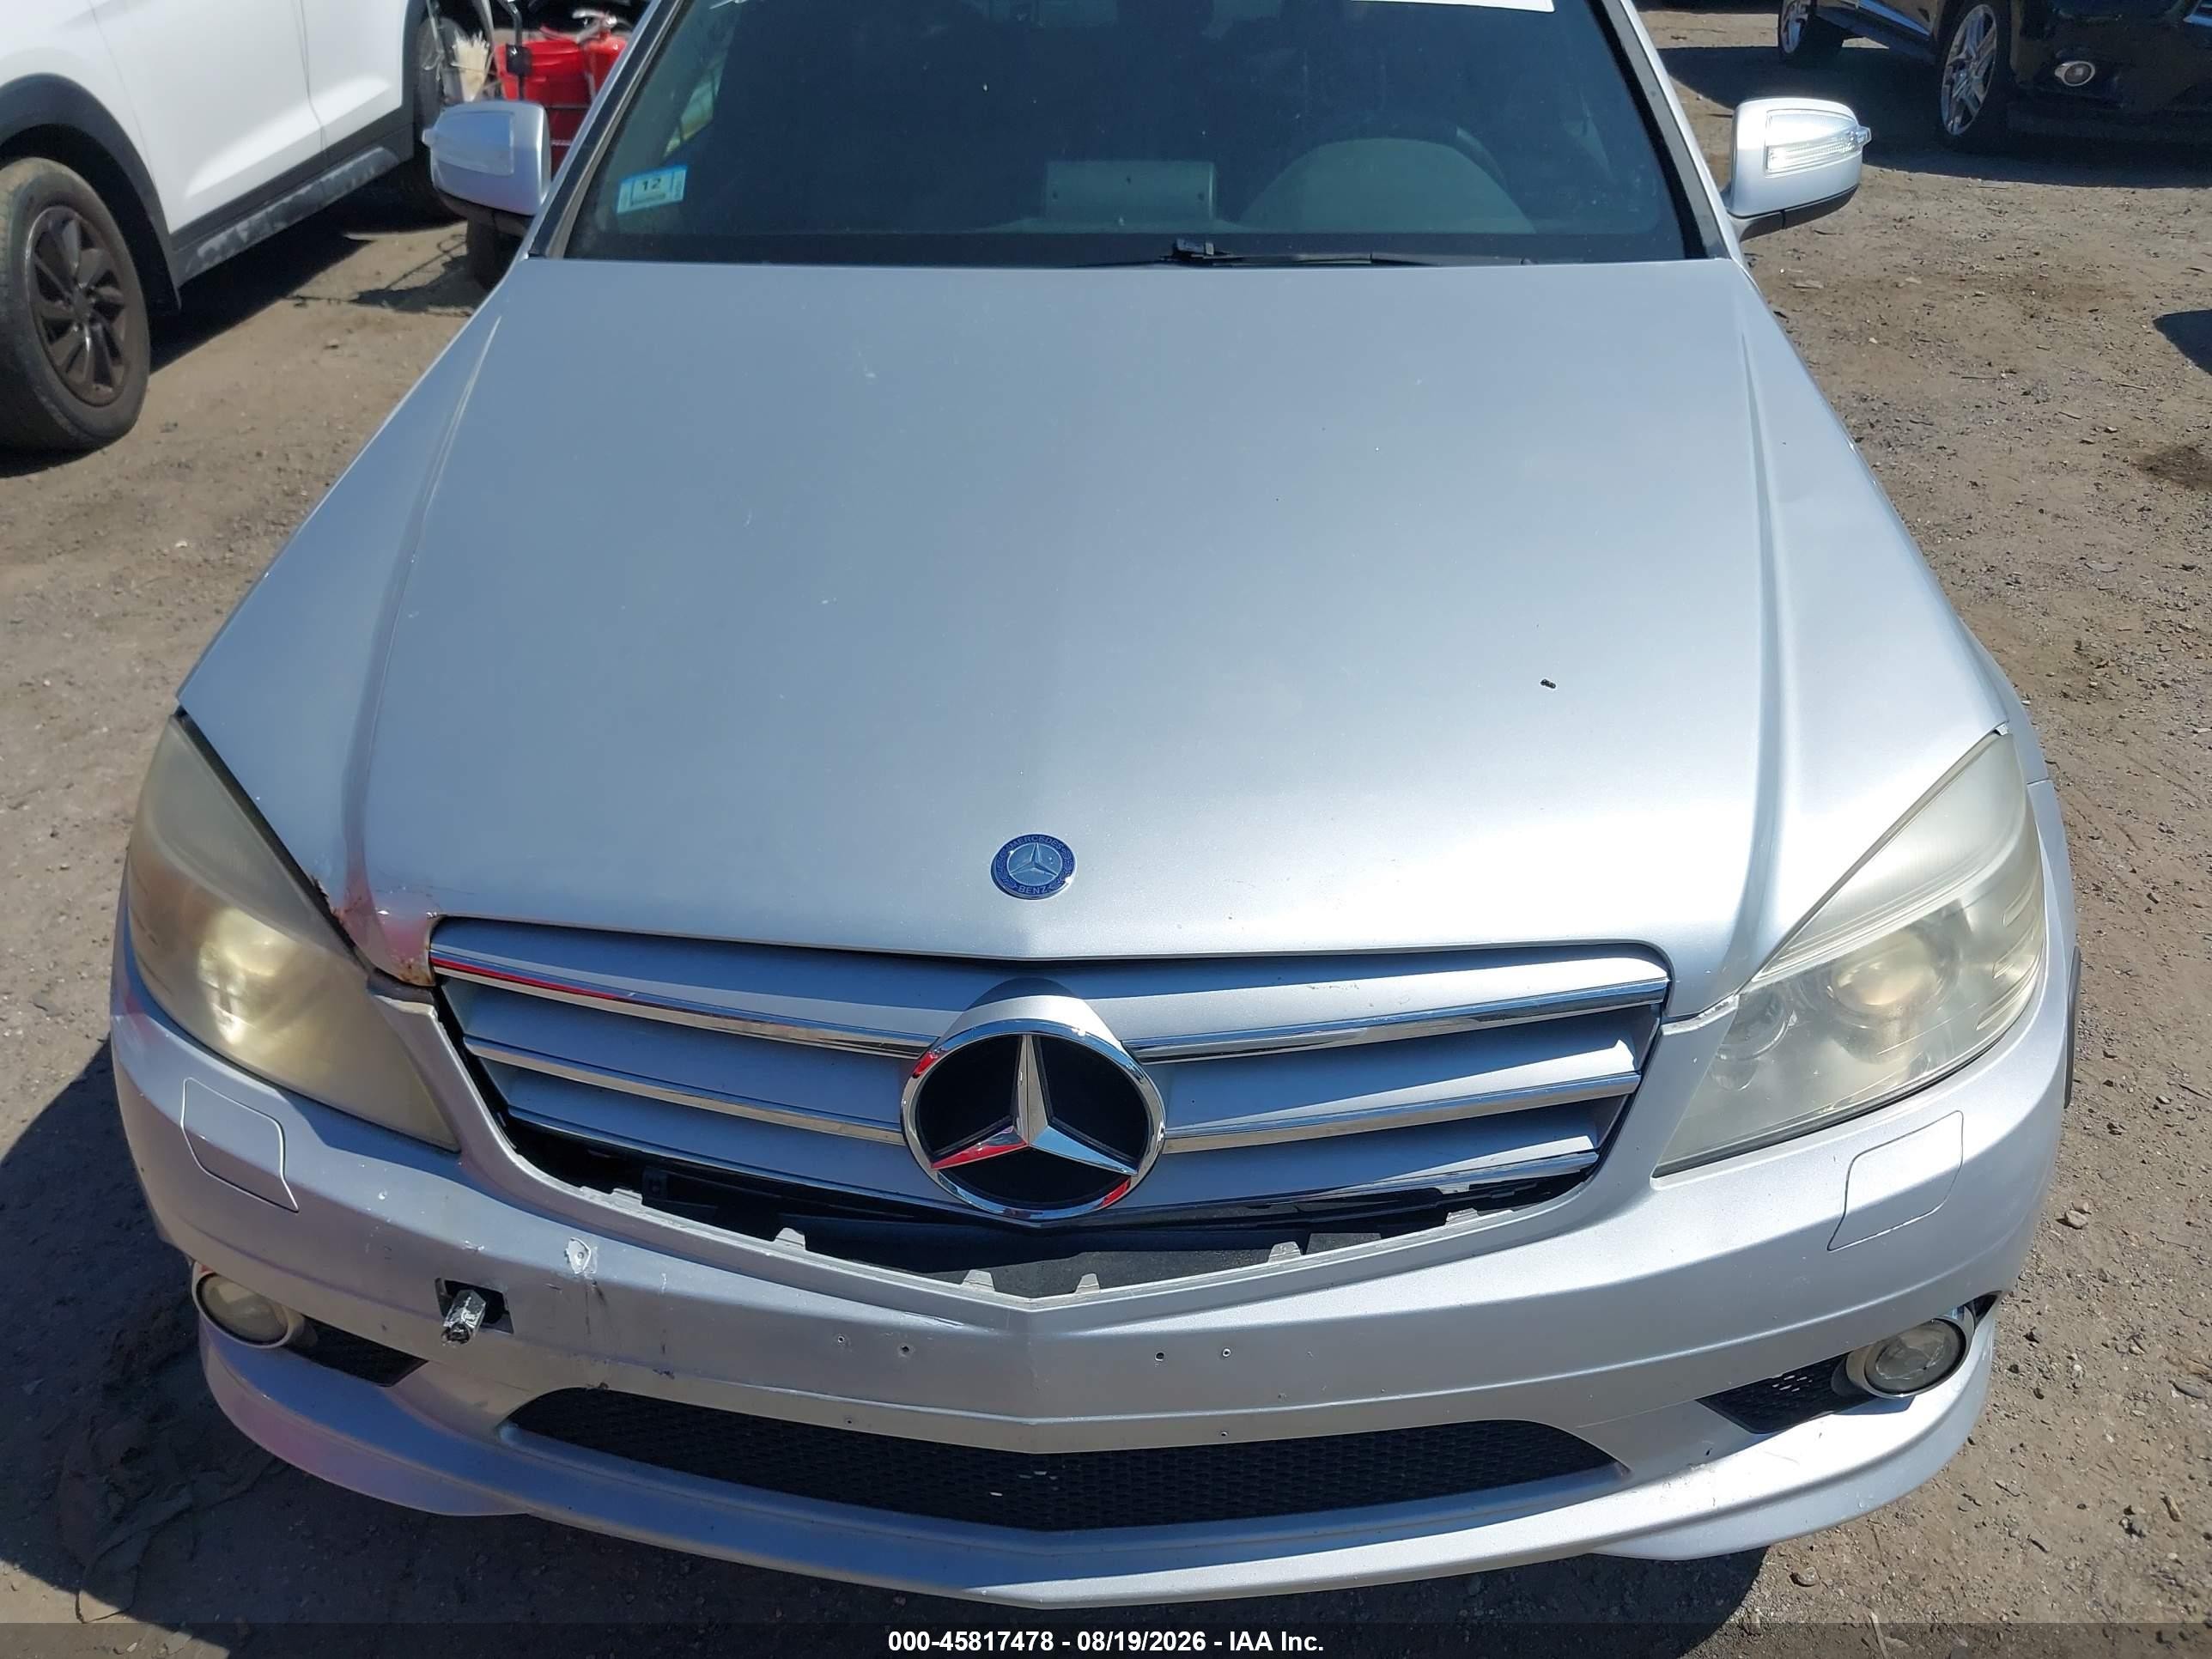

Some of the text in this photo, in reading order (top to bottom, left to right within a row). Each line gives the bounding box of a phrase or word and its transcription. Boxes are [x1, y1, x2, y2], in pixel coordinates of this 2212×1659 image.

[642, 177, 661, 191] 12
[1006, 836, 1062, 850] MERCEDES
[1018, 885, 1048, 894] BENZ
